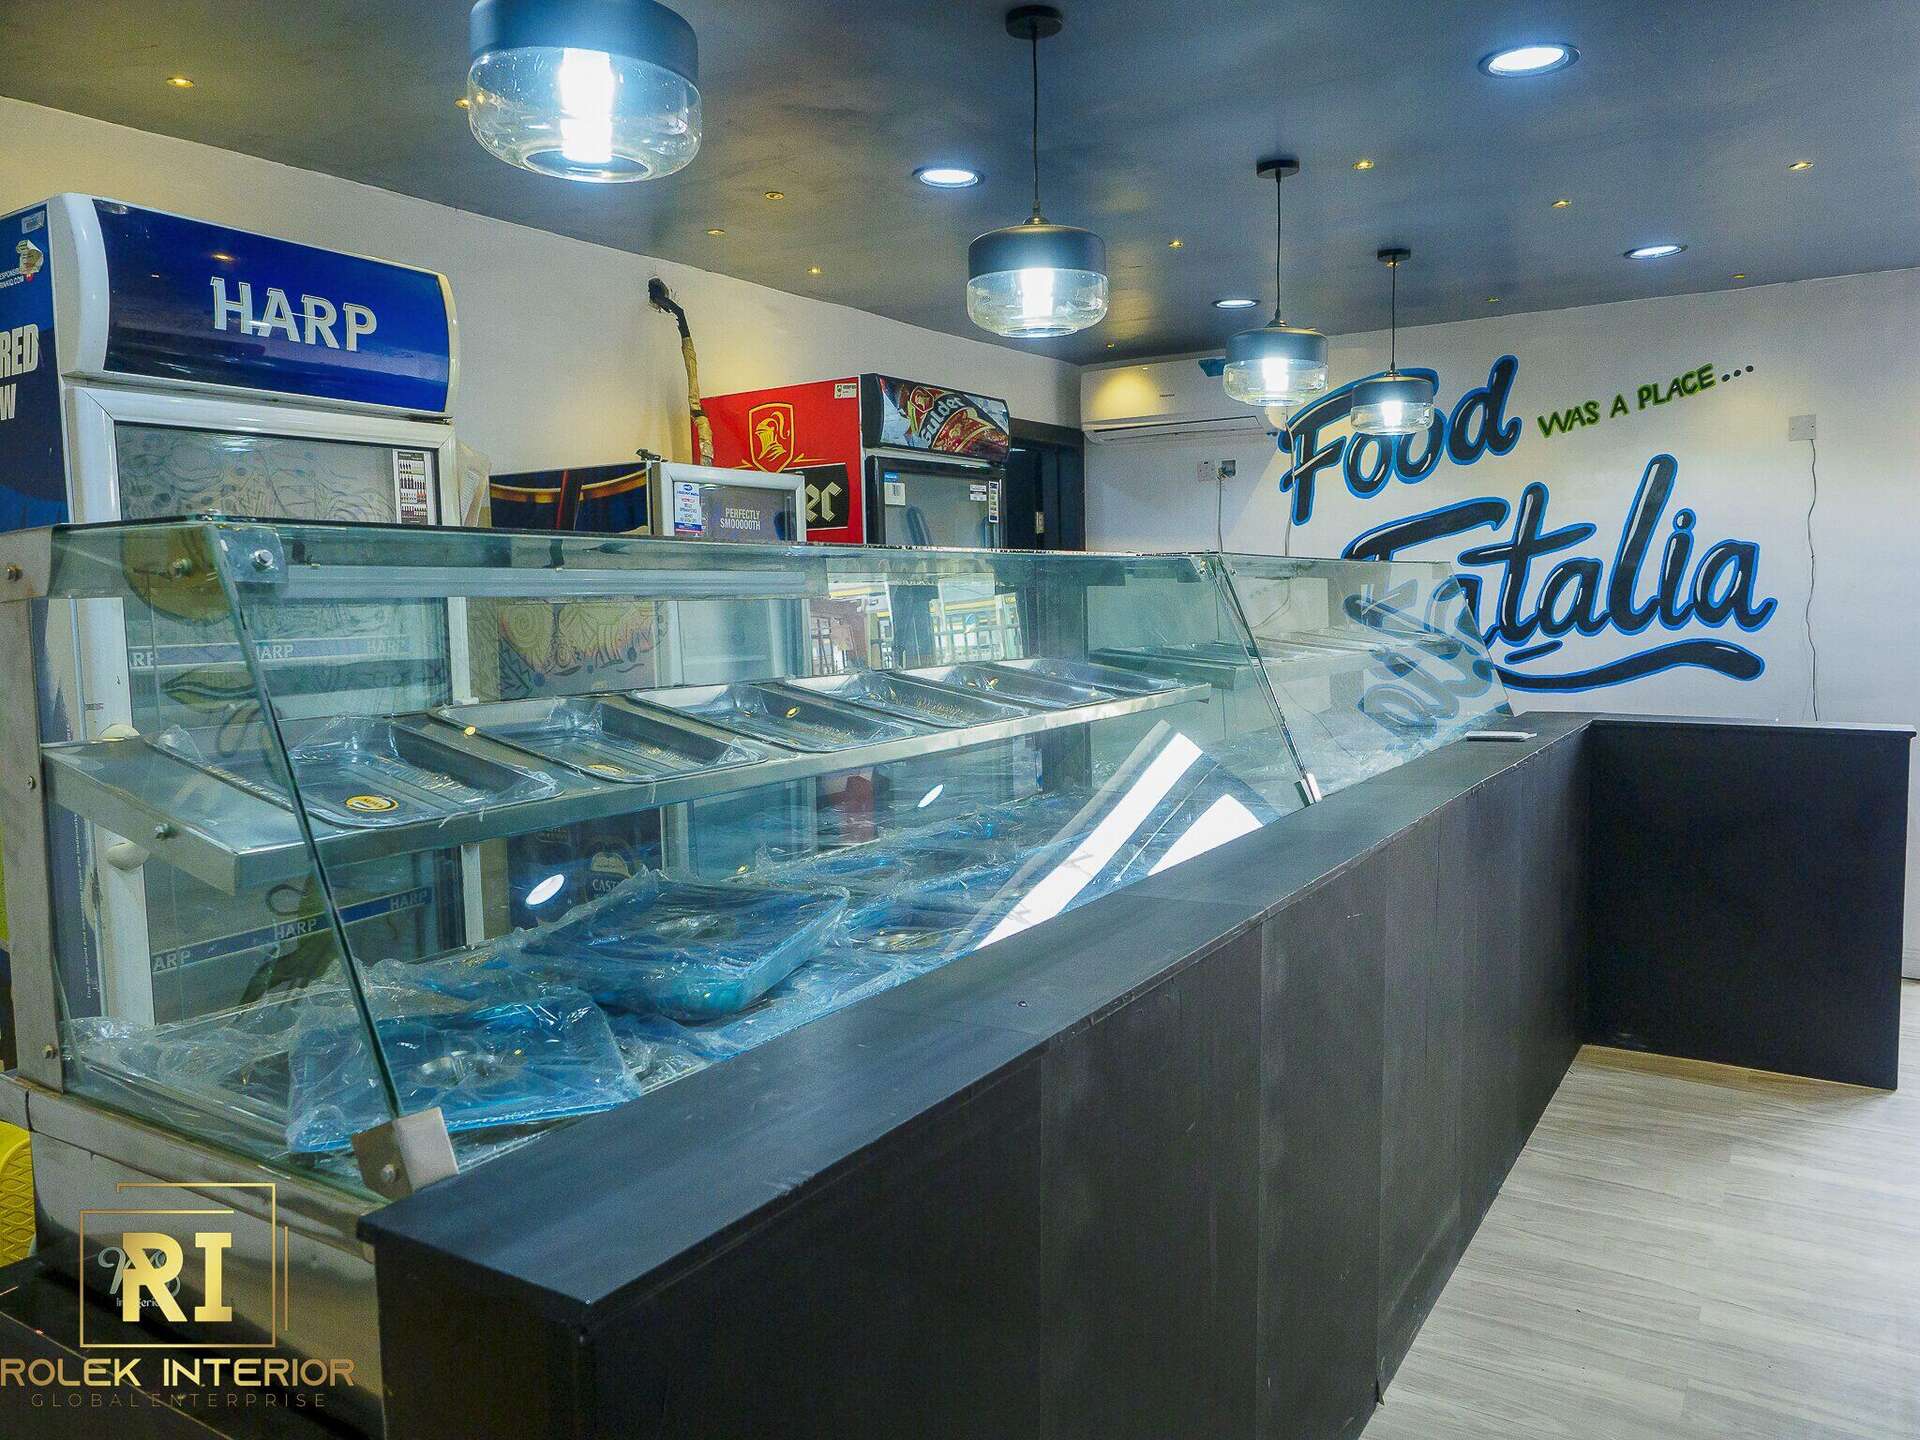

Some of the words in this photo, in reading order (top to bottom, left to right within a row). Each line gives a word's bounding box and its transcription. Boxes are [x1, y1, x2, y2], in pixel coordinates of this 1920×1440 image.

[209, 275, 378, 353] HARP
[1278, 353, 1523, 526] Food
[1537, 400, 1600, 438] WAS
[1609, 393, 1630, 419] A
[725, 507, 761, 520] PERFECTLY
[274, 918, 317, 940] HARP
[390, 889, 428, 910] HARP
